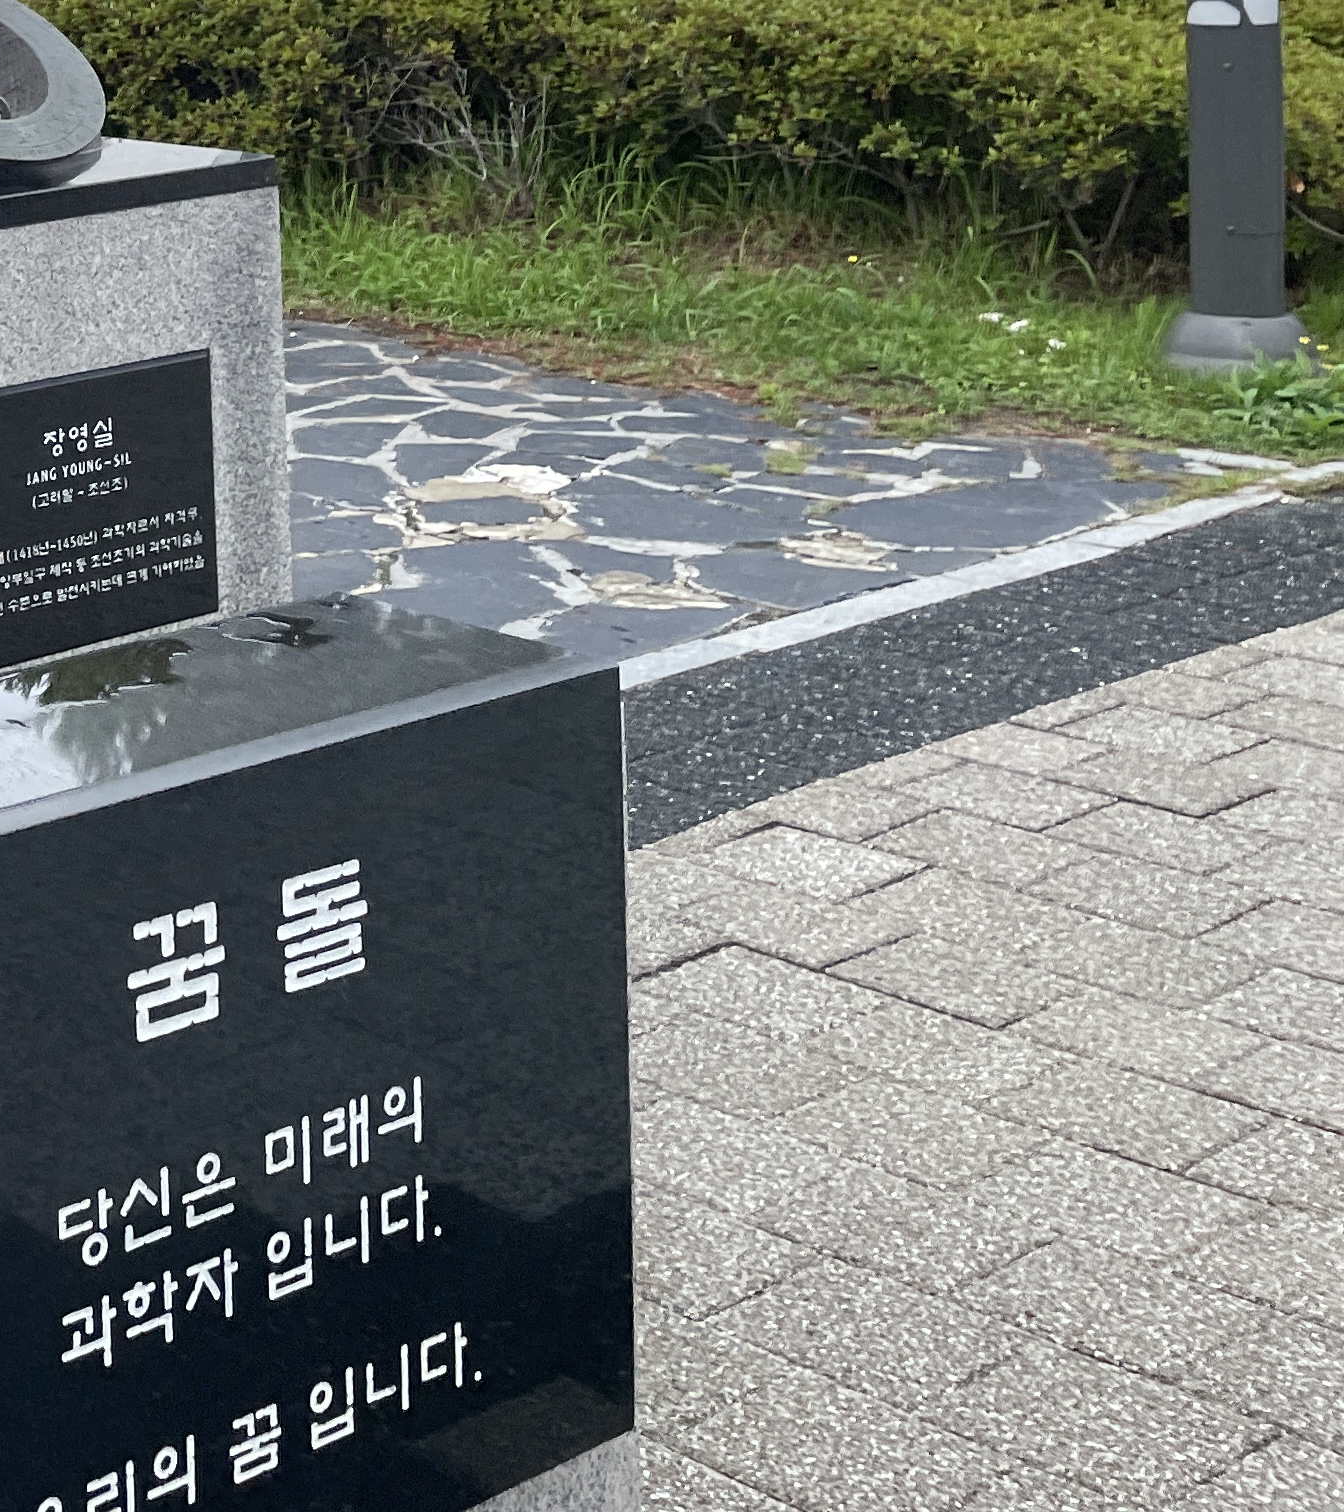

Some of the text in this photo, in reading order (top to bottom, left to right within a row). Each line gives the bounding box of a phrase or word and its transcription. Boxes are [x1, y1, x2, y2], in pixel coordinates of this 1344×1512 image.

[26, 452, 132, 486] JANG YOUNG-SIL
[43, 417, 113, 457] 장영실
[126, 858, 368, 1043] 꿈 돌
[57, 1075, 423, 1267] 당신은 미래의
[61, 1174, 443, 1367] 과학자 입니다.
[228, 1403, 282, 1485] 꿈
[309, 1321, 483, 1451] 입니다.
